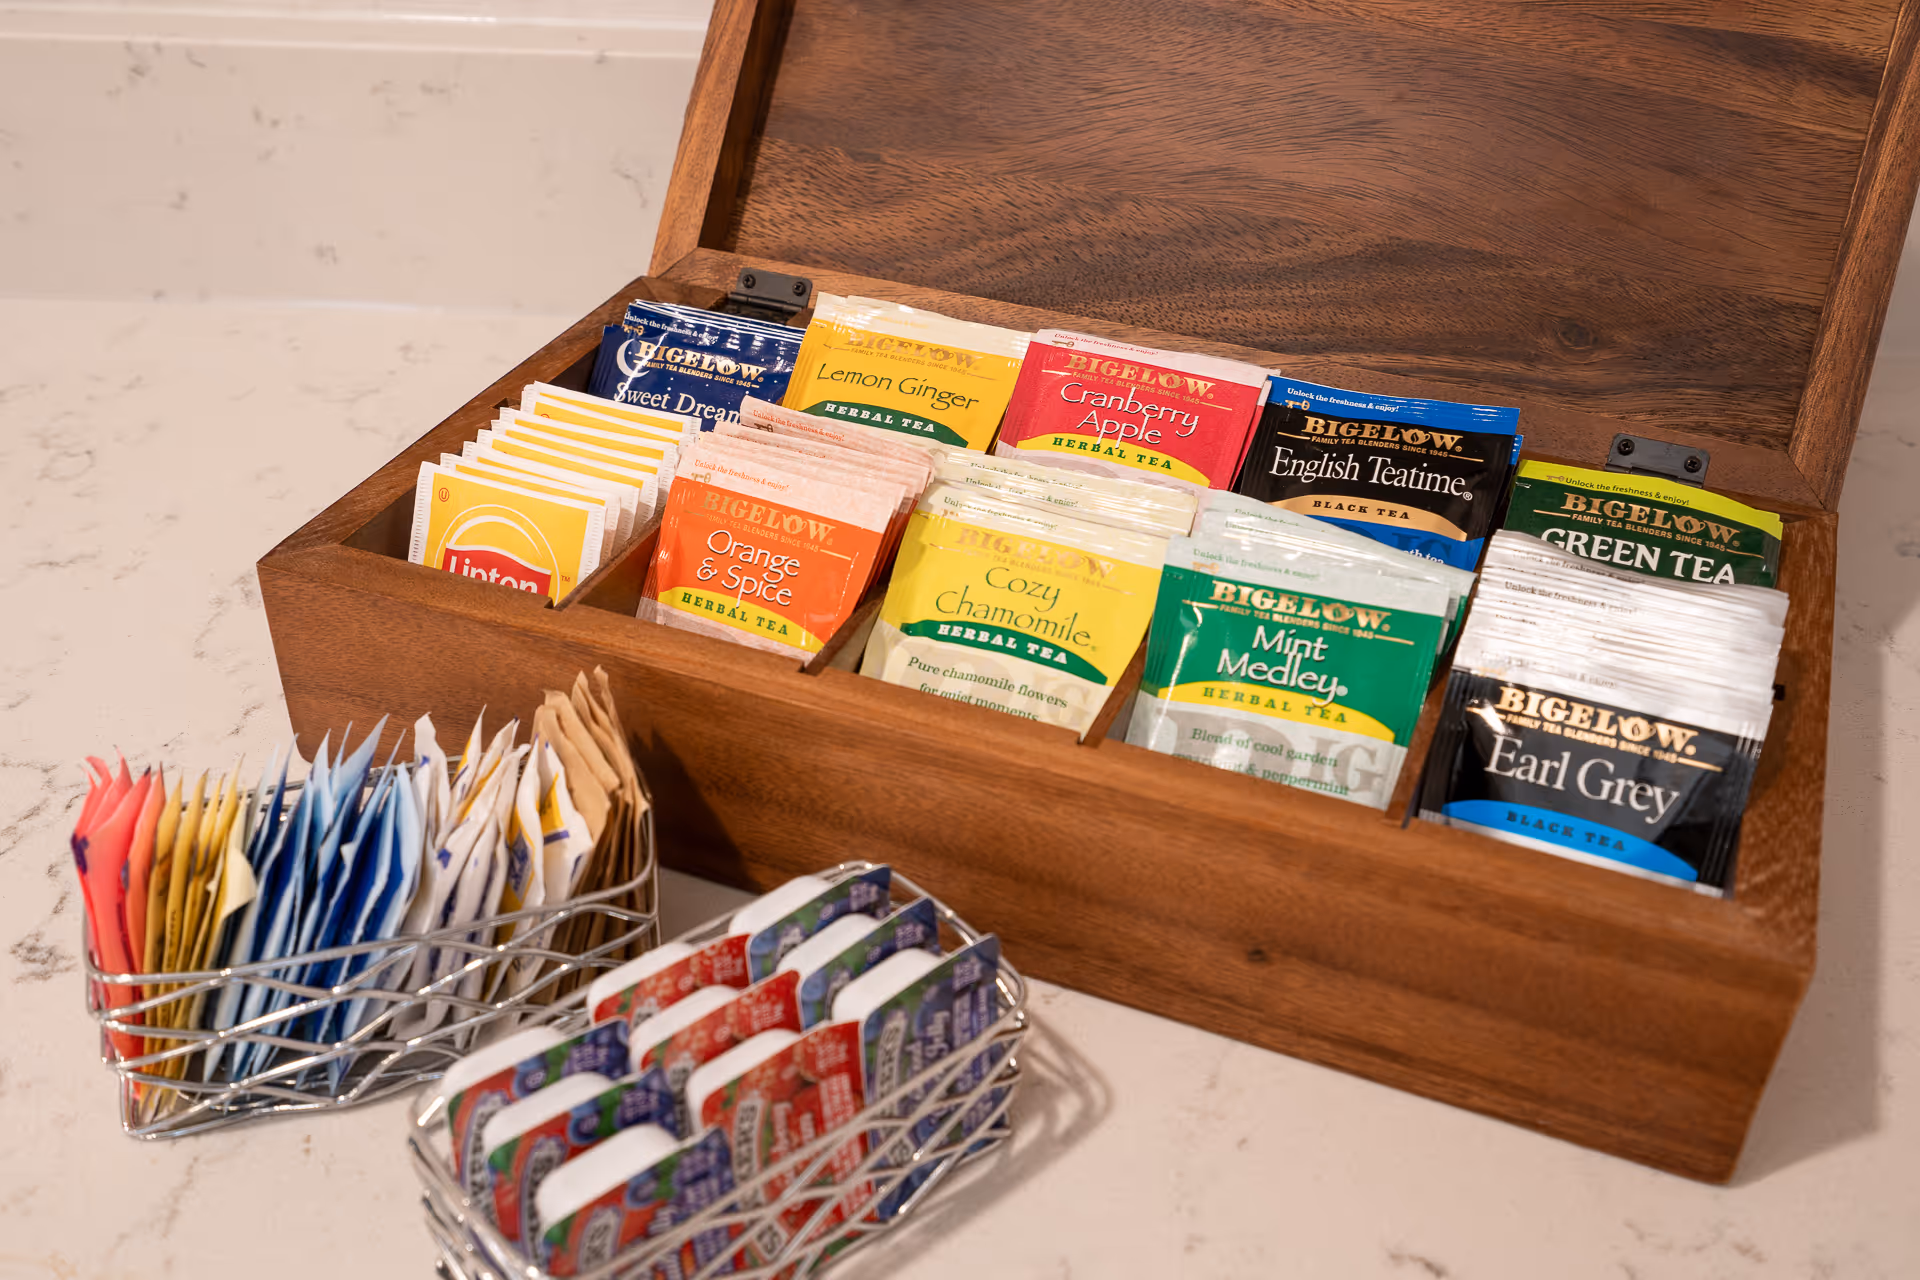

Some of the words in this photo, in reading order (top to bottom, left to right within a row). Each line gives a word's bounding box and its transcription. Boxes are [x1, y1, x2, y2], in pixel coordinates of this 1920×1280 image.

[650, 319, 660, 329] the
[1054, 333, 1079, 342] Unlock
[850, 348, 874, 358] FAMILY
[890, 354, 925, 366] BLENDERS
[666, 364, 678, 372] TEA
[679, 367, 713, 379] BLENDERS
[714, 375, 734, 384] SINCE
[736, 380, 751, 388] 1945
[816, 362, 892, 391] Lemon
[899, 378, 980, 410] Ginger
[1072, 372, 1099, 382] FAMILY
[1100, 376, 1114, 386] TEA
[1116, 380, 1156, 395] BLENDERS
[1158, 388, 1180, 400] SINCE
[1182, 394, 1200, 405] 1945
[614, 382, 672, 409] Sweet
[1060, 382, 1199, 437] Cranberry
[1287, 388, 1315, 401] Unlock
[1316, 394, 1328, 402] the
[1329, 396, 1367, 410] freshness
[1375, 404, 1400, 413] enjoy!
[753, 410, 772, 424] Unlock
[773, 416, 784, 426] the
[825, 402, 894, 424] HERBAL
[902, 418, 935, 432] TEA
[1076, 410, 1162, 449] Apple
[1052, 436, 1126, 460] HERBAL
[1137, 453, 1172, 470] TEA
[1311, 436, 1339, 445] FAMILY
[1341, 438, 1356, 446] TEA
[1358, 440, 1400, 450] BLENDERS
[1402, 445, 1427, 454] SINCE
[1429, 449, 1448, 458] 1945
[694, 459, 716, 472] Unlock
[717, 464, 727, 474] the
[728, 468, 760, 484] freshness
[1269, 446, 1360, 484] English
[1566, 477, 1594, 490] Unlock
[1596, 483, 1611, 492] the
[1612, 485, 1653, 498] freshness
[1663, 494, 1690, 506] enjoy!
[1312, 501, 1368, 514] BLACK
[1377, 508, 1410, 520] TEA
[743, 524, 778, 542] BLENDERS
[780, 535, 801, 548] SINCE
[803, 541, 819, 552] 1945
[1572, 514, 1604, 524] FAMILY
[1606, 519, 1623, 529] TEA
[1625, 524, 1673, 539] BLENDERS
[1676, 533, 1702, 545] SINCE
[1705, 540, 1726, 552] 1945
[707, 530, 800, 584] Orange
[1194, 548, 1224, 562] Unlock
[1226, 556, 1239, 565] the
[1541, 528, 1661, 572] GREEN
[1670, 550, 1736, 584] TEA
[697, 558, 718, 581] &
[722, 565, 792, 608] Spice
[986, 566, 1060, 613] Cozy
[1505, 581, 1537, 595] Unlock
[682, 592, 748, 622] HERBAL
[756, 616, 788, 636] TEA
[1219, 604, 1251, 616] FAMILY
[1254, 610, 1270, 620] TEA
[937, 624, 1018, 650] HERBAL
[1027, 642, 1067, 666] TEA
[1252, 625, 1328, 662] Mint
[908, 656, 940, 675] Pure
[942, 666, 1015, 692] chamomile
[1018, 684, 1068, 709] flowers
[920, 683, 938, 696] for
[1204, 687, 1292, 712] HERBAL
[1305, 706, 1348, 724] TEA
[1506, 714, 1542, 729] FAMILY
[1542, 722, 1562, 736] TEA
[1192, 728, 1232, 746] Blend
[1236, 736, 1252, 749] of
[1254, 740, 1283, 756] cool
[1286, 750, 1338, 768] garden
[1262, 768, 1350, 796] peppermint
[1484, 734, 1571, 790] Earl
[1577, 758, 1680, 824] Grey
[1507, 810, 1574, 838] BLACK
[1584, 832, 1626, 851] TEA
